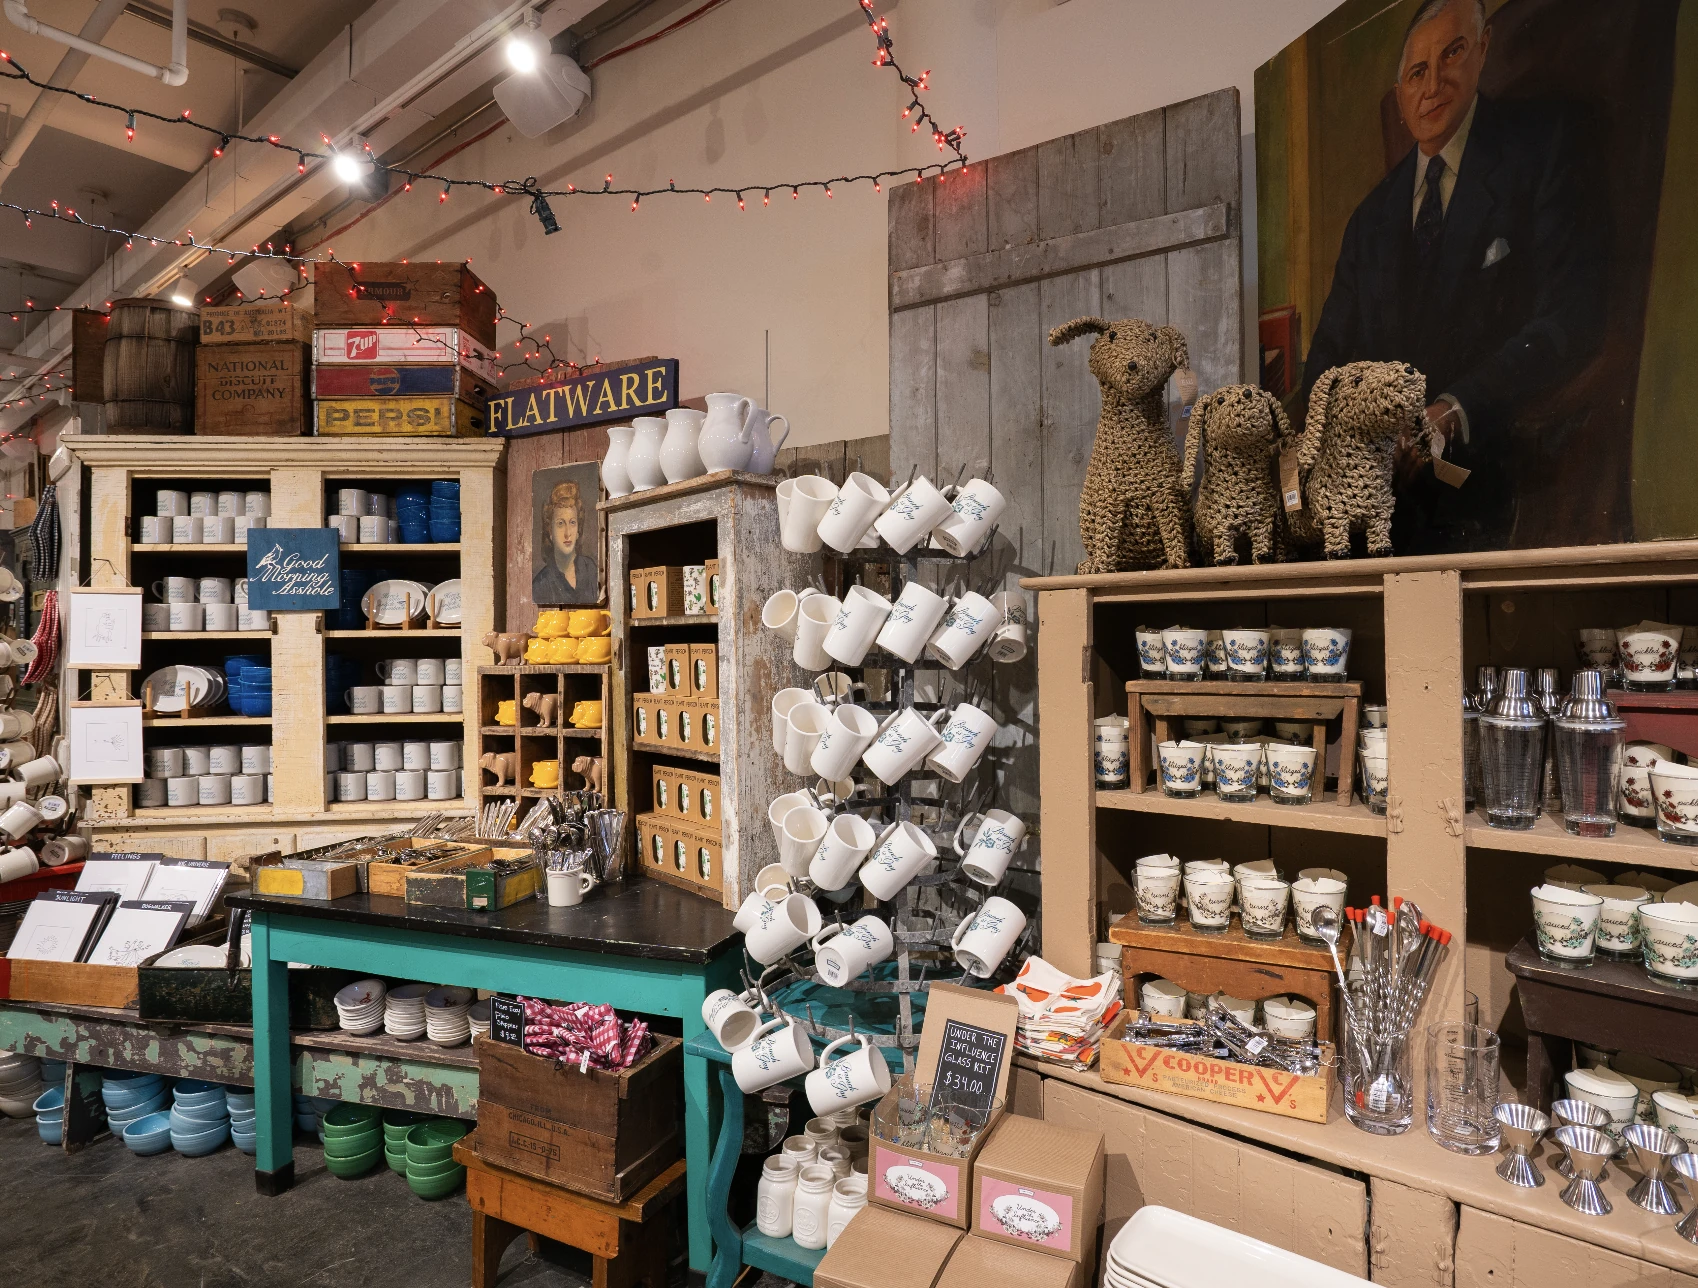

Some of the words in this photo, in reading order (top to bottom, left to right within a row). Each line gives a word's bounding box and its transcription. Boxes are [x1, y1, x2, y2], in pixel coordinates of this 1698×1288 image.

[244, 308, 274, 316] AUSTRALIA
[202, 319, 236, 336] B43
[207, 359, 289, 373] NATIONAL
[220, 374, 278, 387] BISCUIT
[211, 387, 287, 401] COMPANY
[487, 366, 668, 433] FLATWARE
[325, 407, 442, 427] PEPSI
[281, 552, 329, 574] Good
[250, 565, 331, 588] Morning
[272, 580, 335, 596] Asshole
[1148, 643, 1163, 654] blitz
[1178, 642, 1199, 655] blitzed
[1236, 642, 1259, 655] blitzed
[1308, 642, 1331, 655] blitzed
[1633, 646, 1660, 656] pickled
[1101, 754, 1121, 765] blitzed
[1167, 760, 1189, 771] blitzed
[1223, 763, 1247, 774] blitzed
[1279, 764, 1303, 776] blitzed
[55, 894, 86, 903] SUNLIGHT
[1150, 891, 1170, 899] turnt
[1544, 921, 1572, 931] sauced
[1600, 917, 1629, 926] sauced
[1653, 937, 1684, 949] sauced
[950, 1026, 977, 1043] UNDER
[982, 1036, 999, 1048] THE
[950, 1040, 997, 1063] INFLUENCE
[944, 1052, 972, 1068] GLASS
[974, 1062, 992, 1074] KIT
[1163, 1055, 1254, 1087] COOPER
[943, 1070, 983, 1095] $34.00
[1162, 1074, 1210, 1088] PASTEURIZED
[1213, 1083, 1247, 1094] PROCESS
[1197, 1076, 1219, 1085] BRAND
[1172, 1082, 1206, 1093] AMERICAN
[1209, 1088, 1238, 1099] CHEESE
[530, 1103, 552, 1114] FROM
[906, 1173, 926, 1184] Under
[1016, 1204, 1036, 1214] Under
